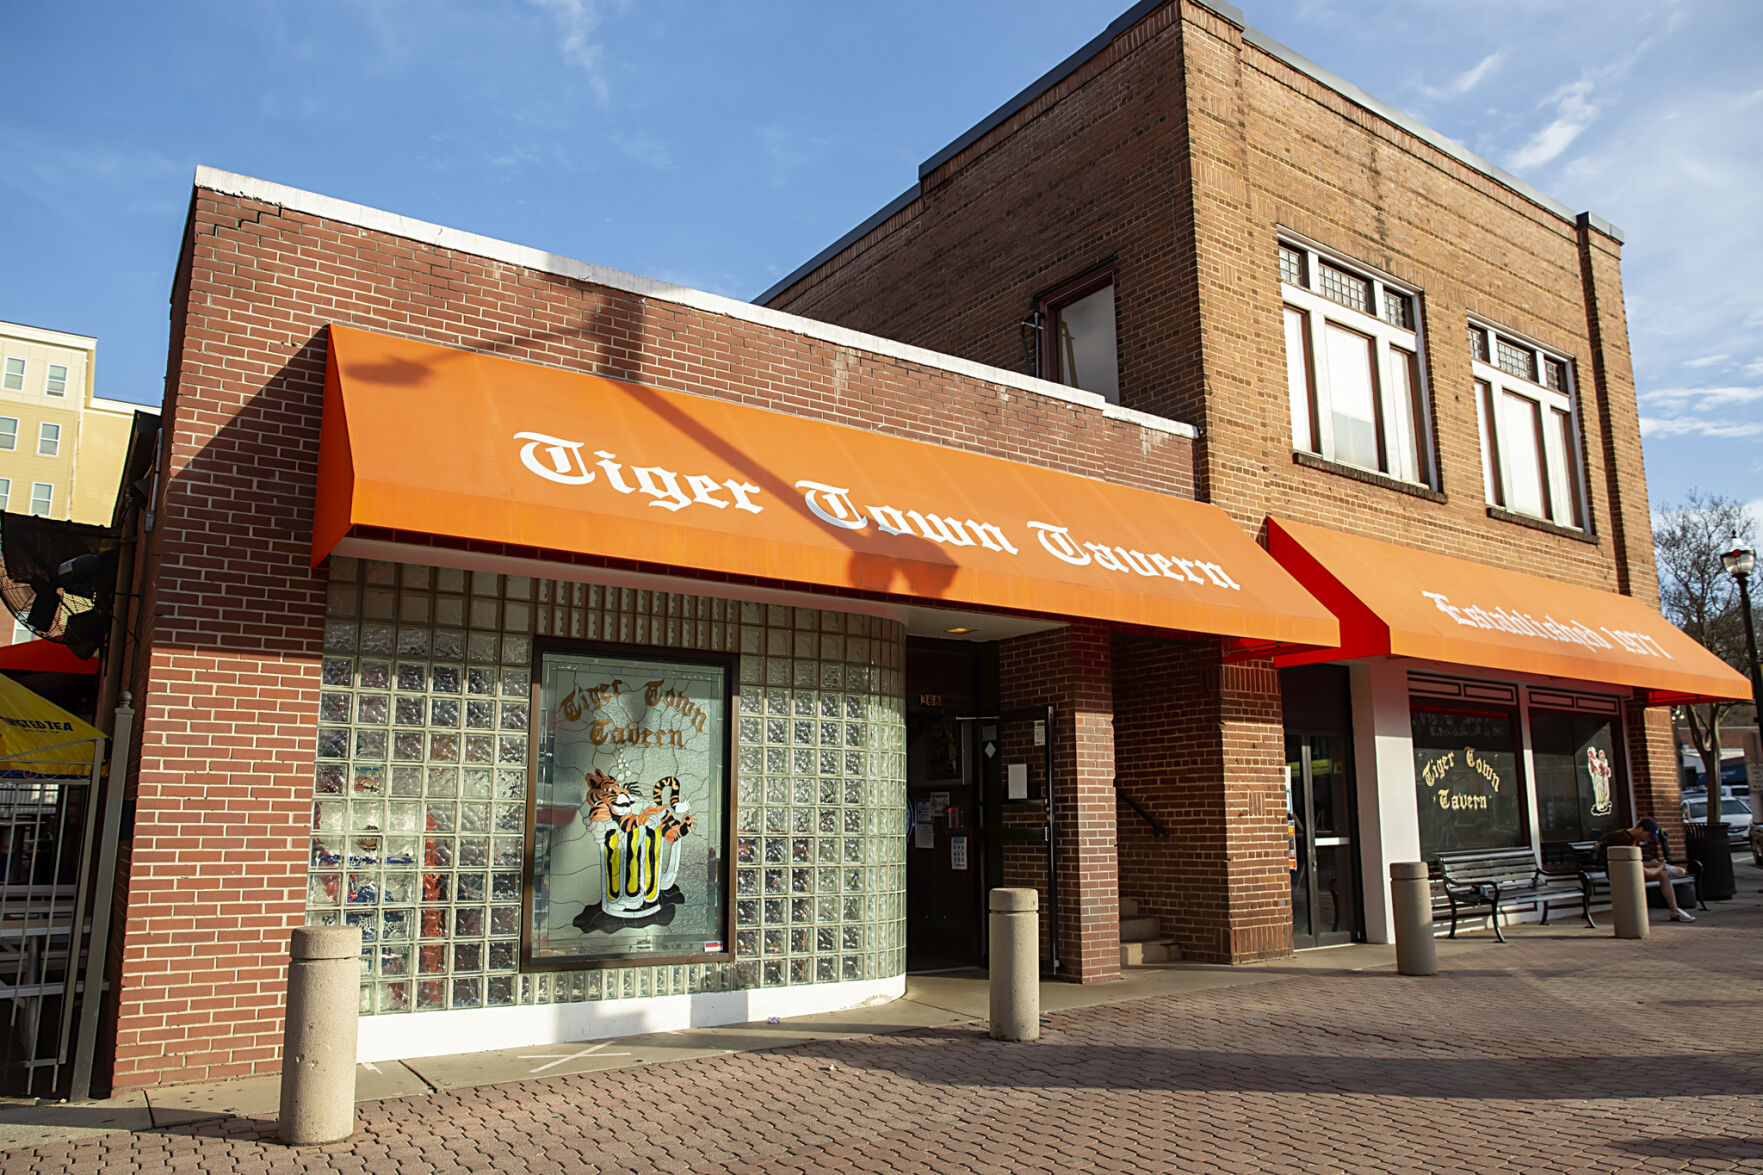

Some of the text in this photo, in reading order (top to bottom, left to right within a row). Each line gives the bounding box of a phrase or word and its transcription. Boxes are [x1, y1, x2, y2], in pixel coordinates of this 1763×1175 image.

[513, 431, 1240, 591] Tiger Town Tavern
[1421, 590, 1674, 659] Established 1977
[561, 679, 706, 732] Tiger Town
[589, 719, 683, 748] Tavern
[1422, 746, 1500, 793] Tiger Town
[1438, 789, 1488, 811] Tavern
